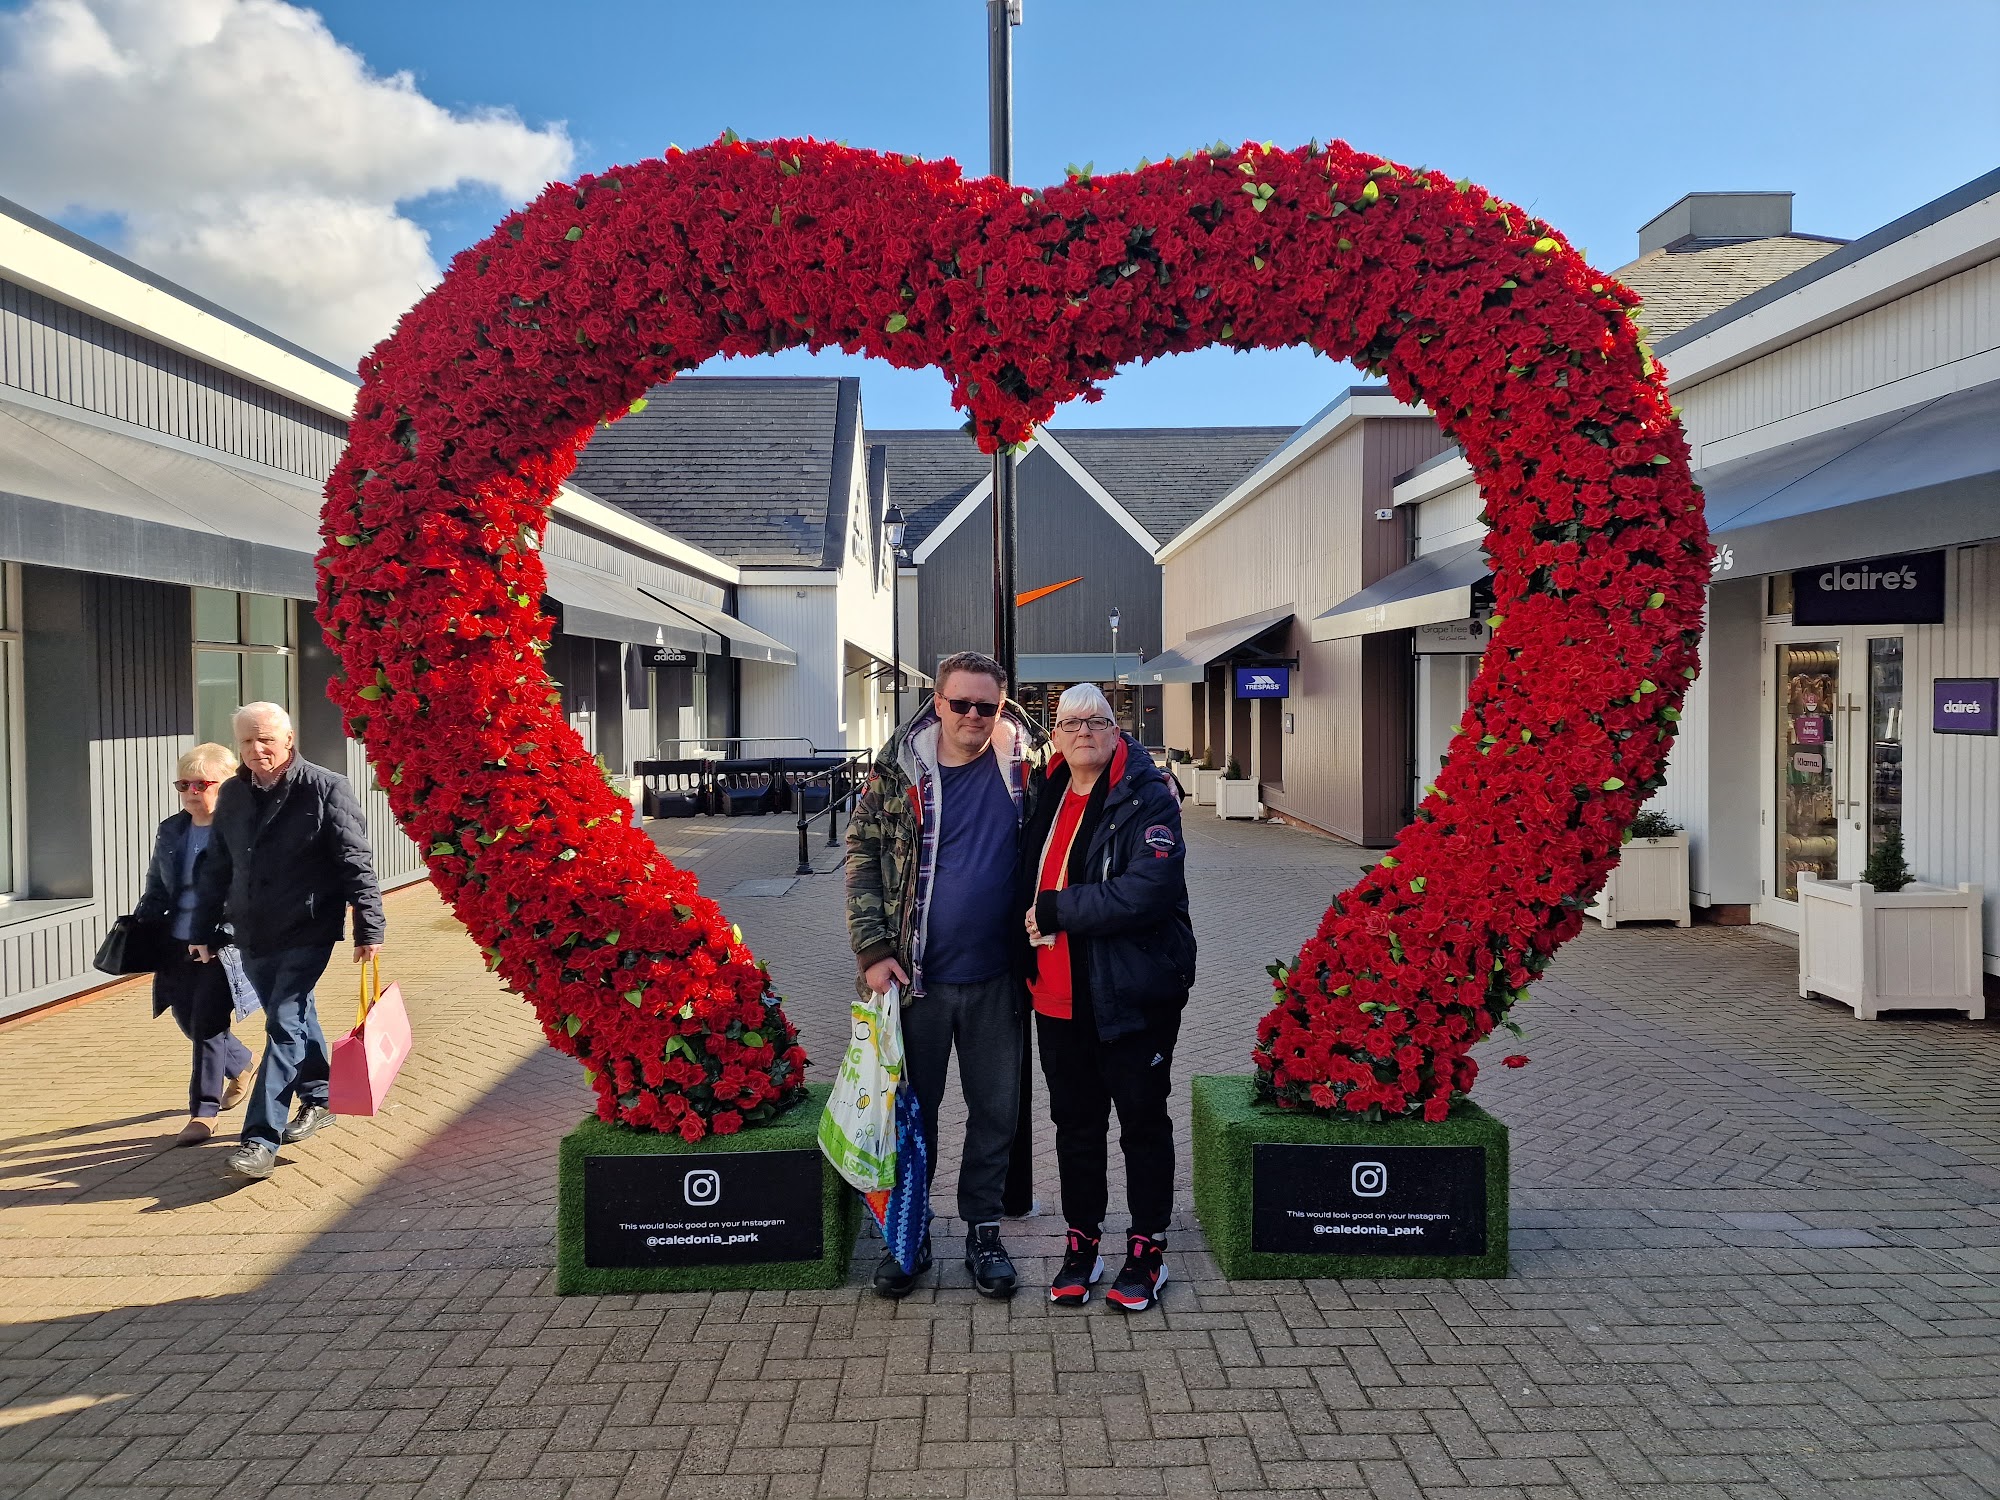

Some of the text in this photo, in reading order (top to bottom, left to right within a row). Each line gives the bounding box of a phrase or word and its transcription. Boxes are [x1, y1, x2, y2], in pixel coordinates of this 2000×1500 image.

[1819, 565, 1917, 591] claire's
[1422, 624, 1468, 635] Grape Tree
[654, 653, 686, 661] adidas
[1944, 700, 1980, 714] claire's
[1286, 1210, 1305, 1218] This
[1332, 1211, 1351, 1219] look
[1351, 1212, 1374, 1221] good
[1387, 1213, 1406, 1221] your
[1407, 1212, 1450, 1222] Instagram
[638, 1222, 665, 1230] would
[665, 1221, 684, 1229] look
[684, 1221, 708, 1231] good
[721, 1221, 740, 1229] your
[741, 1219, 786, 1228] Instagram
[1313, 1224, 1425, 1237] @caledonia_park
[646, 1232, 760, 1247] @caledonia_park
